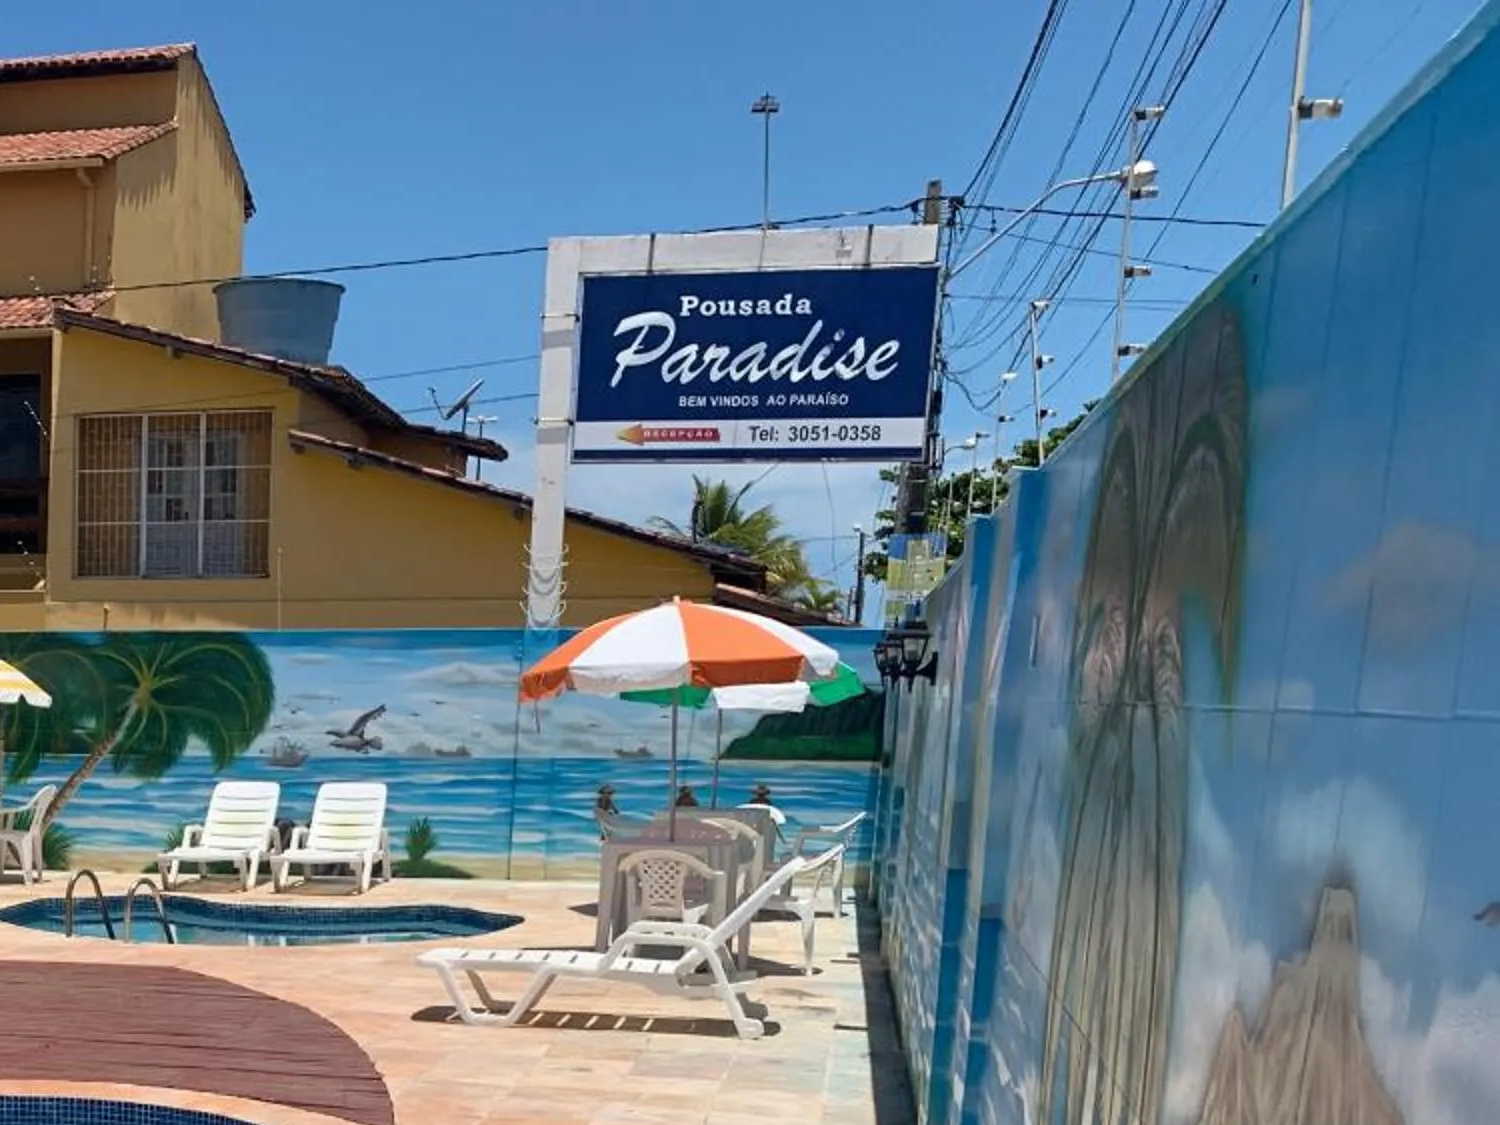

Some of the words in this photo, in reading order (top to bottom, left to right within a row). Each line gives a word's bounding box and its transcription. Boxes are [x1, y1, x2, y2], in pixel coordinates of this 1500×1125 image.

[679, 293, 813, 317] Pousada
[609, 311, 900, 388] Paradise
[679, 395, 707, 407] BEM
[710, 395, 759, 407] VINDOS
[766, 394, 787, 406] AO
[789, 391, 849, 406] PARAÍSO
[750, 426, 779, 443] Tel:
[788, 425, 882, 443] 3051-0358
